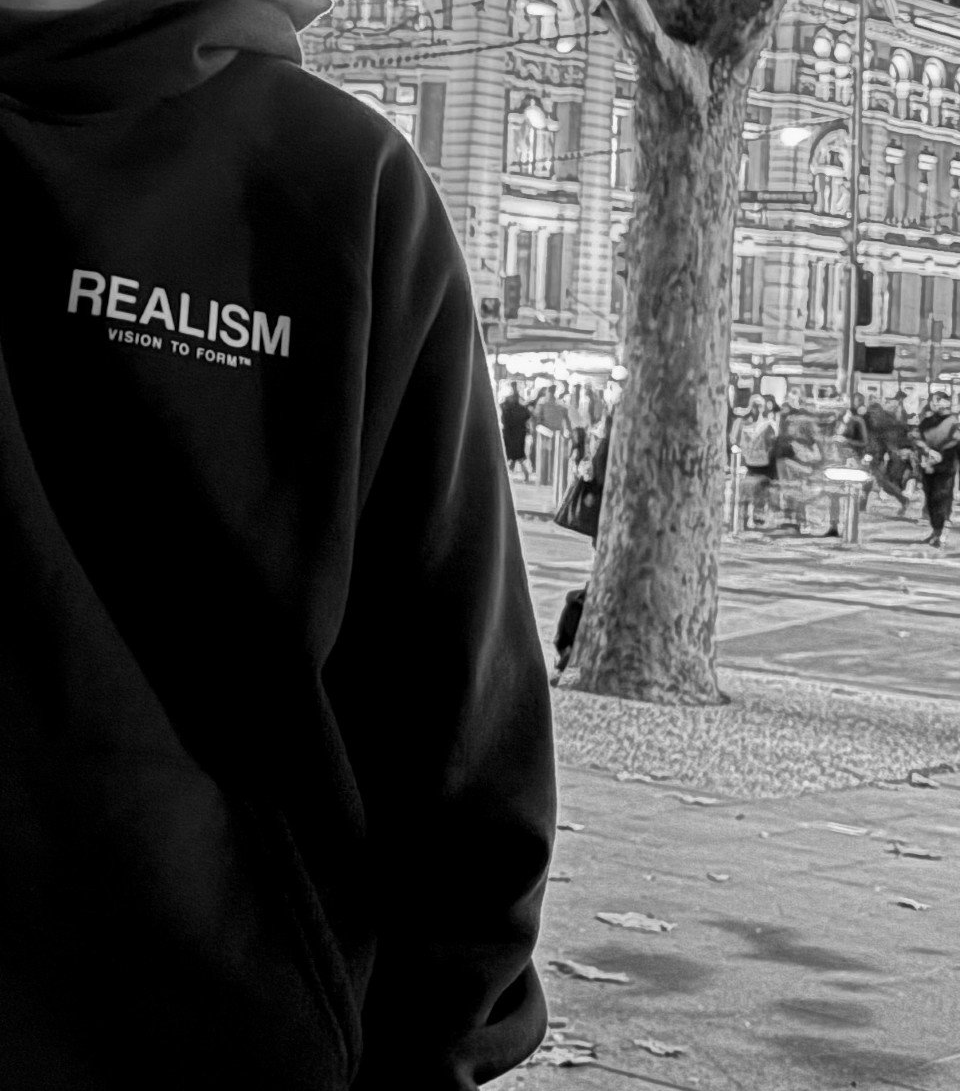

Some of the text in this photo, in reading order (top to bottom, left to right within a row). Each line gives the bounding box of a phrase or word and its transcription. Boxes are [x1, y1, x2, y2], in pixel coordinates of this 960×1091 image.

[67, 268, 291, 357] REALISM
[108, 327, 162, 349] VISION
[170, 340, 190, 356] TO
